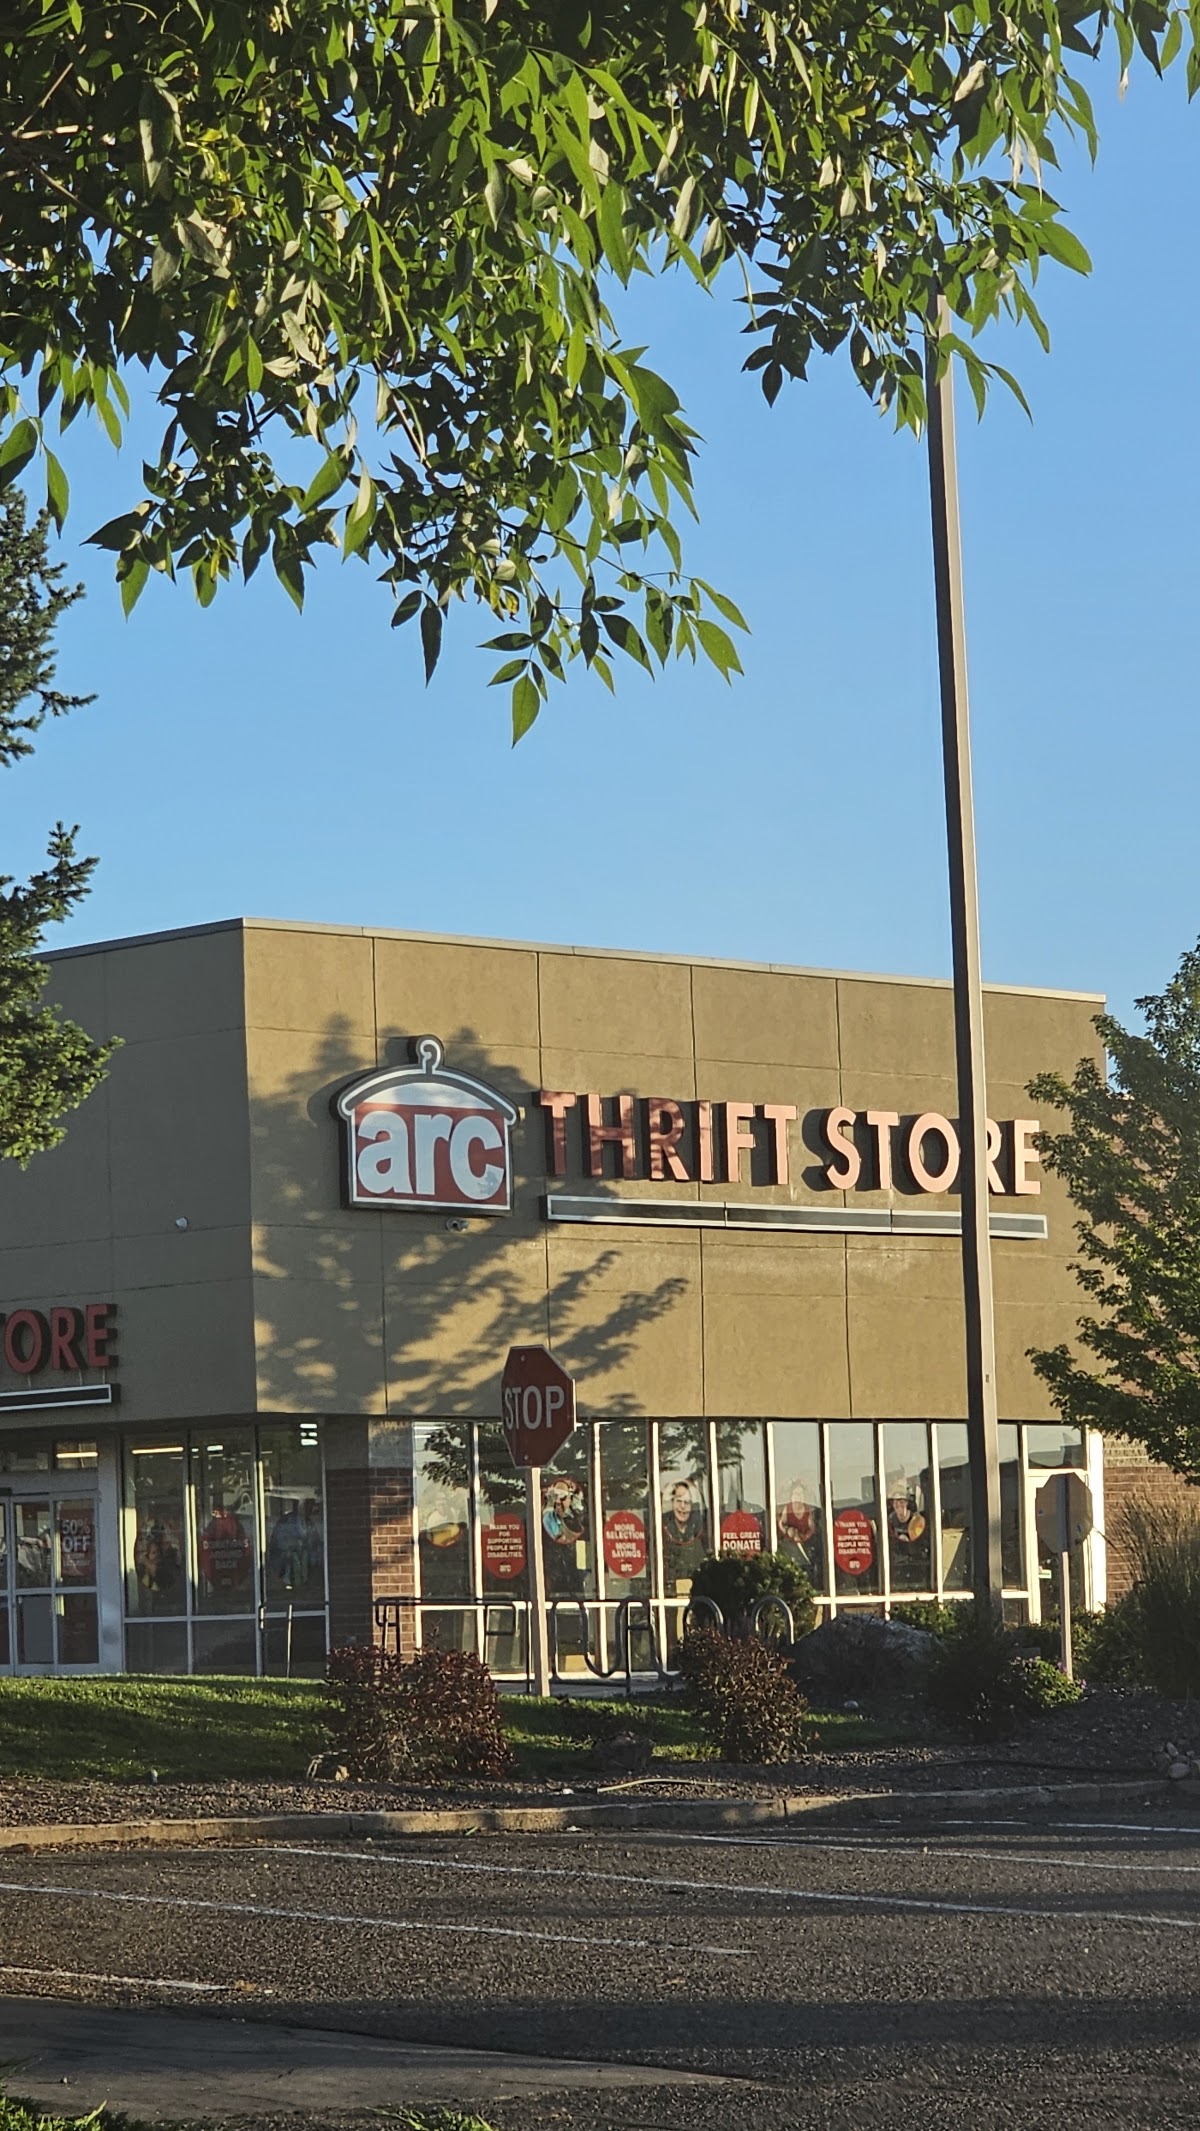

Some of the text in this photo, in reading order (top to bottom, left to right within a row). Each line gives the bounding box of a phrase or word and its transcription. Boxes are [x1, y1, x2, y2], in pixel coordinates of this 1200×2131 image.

[540, 1090, 797, 1185] THRIFT
[357, 1110, 505, 1200] arc
[0, 1304, 110, 1374] ORE
[504, 1385, 565, 1430] STOP
[62, 1517, 91, 1534] 50%
[614, 1524, 635, 1532] MORE
[606, 1531, 645, 1539] SELECTION
[739, 1531, 760, 1539] GREAT
[62, 1535, 91, 1553] OFF
[615, 1542, 636, 1550] MORE
[722, 1540, 761, 1550] DONATE
[611, 1549, 641, 1558] SAVINGS
